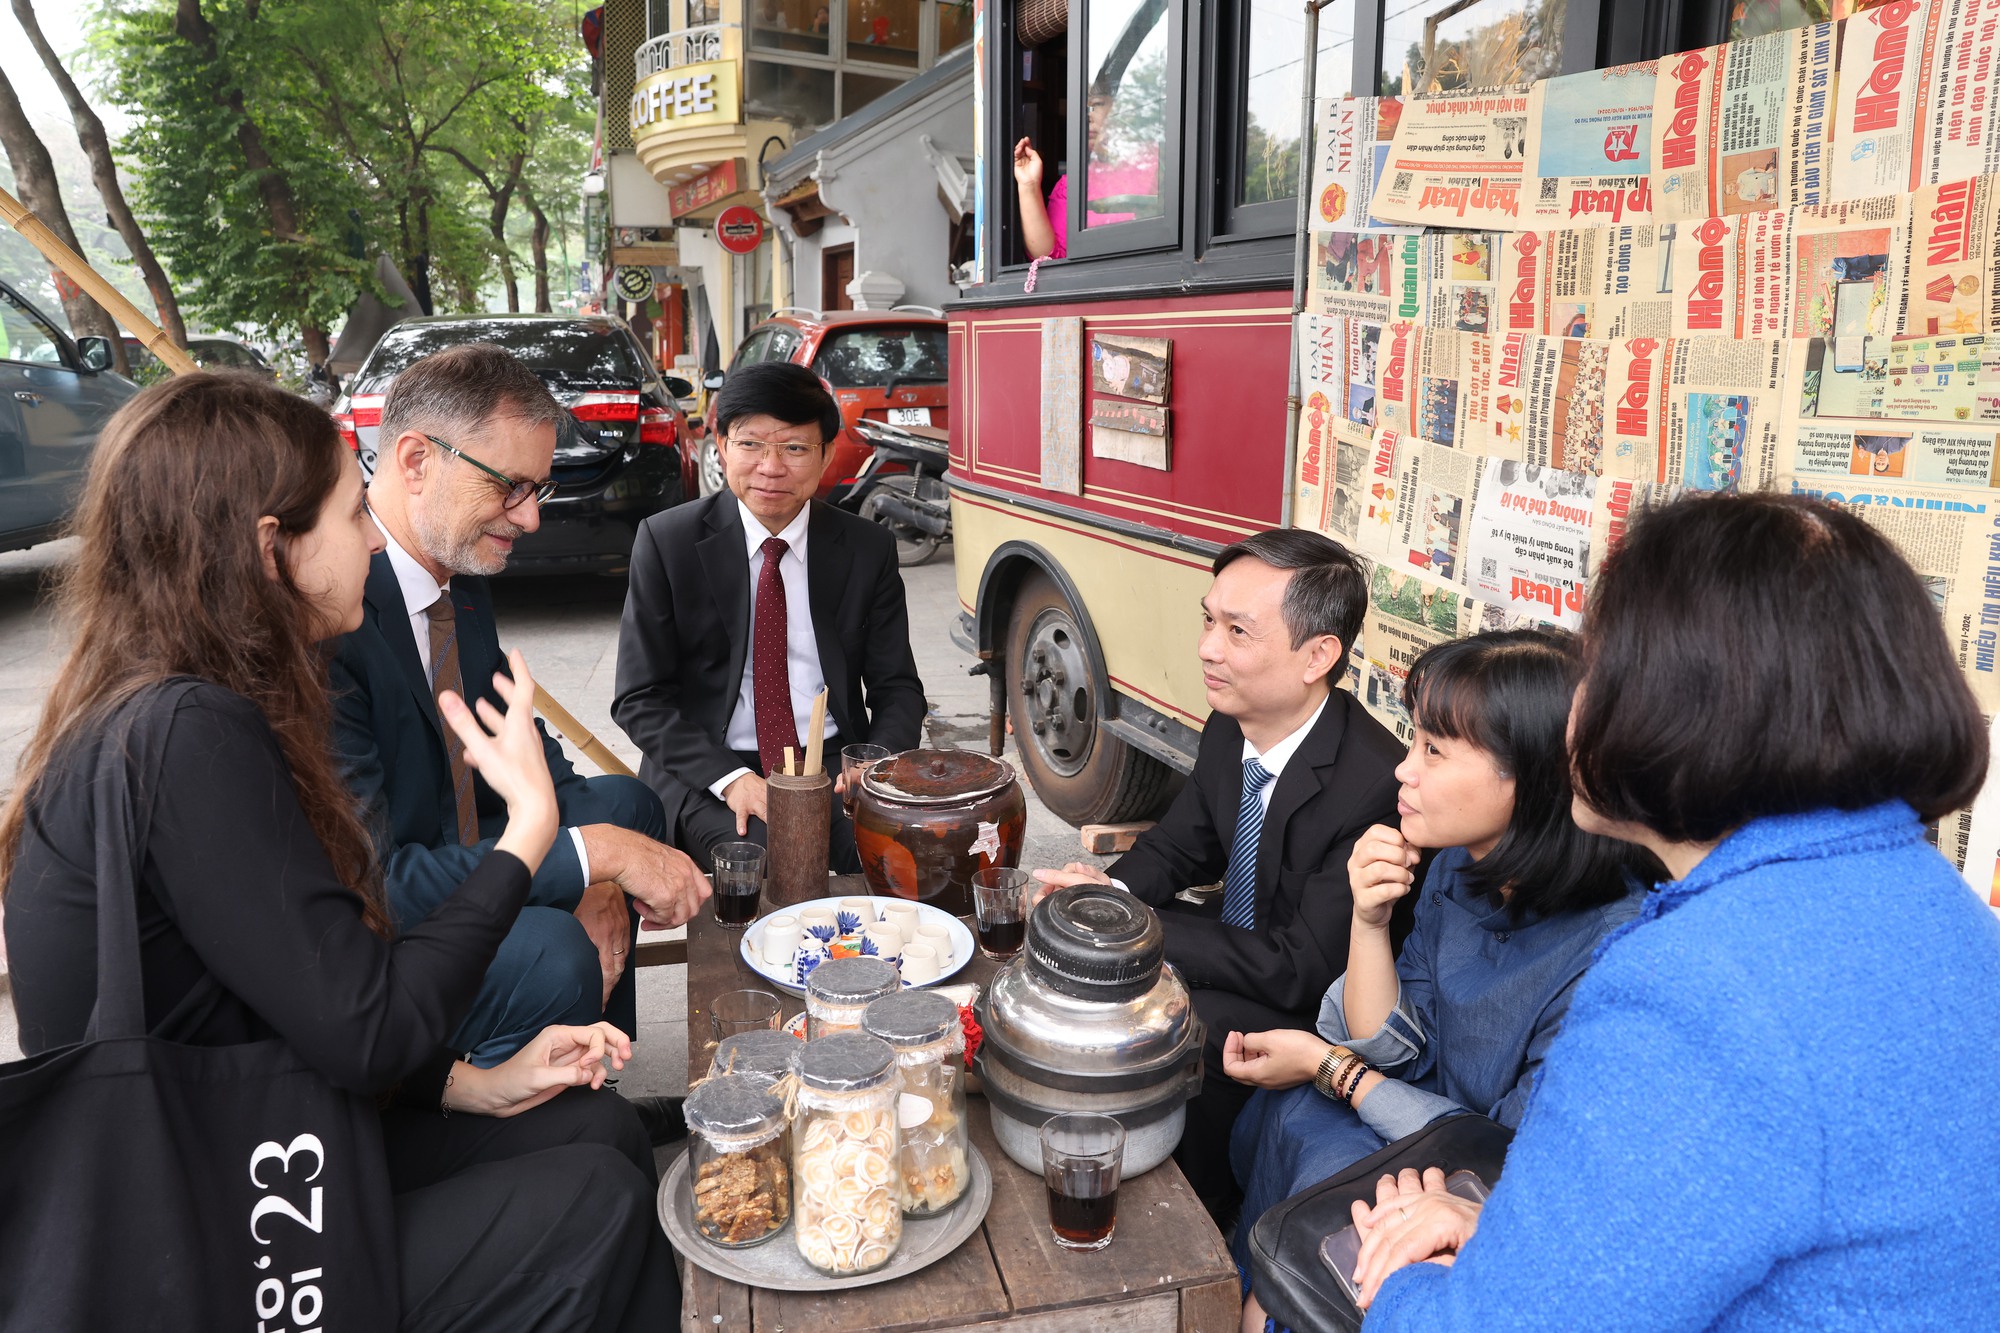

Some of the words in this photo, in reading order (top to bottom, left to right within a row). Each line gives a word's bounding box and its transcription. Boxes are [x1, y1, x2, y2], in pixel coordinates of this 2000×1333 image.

[1924, 20, 1936, 52] QUYẾT
[1979, 14, 1999, 42] hội,
[1811, 42, 1829, 65] LĨNH
[1954, 30, 1975, 70] nhiều
[1715, 53, 1725, 71] CỦA
[1922, 56, 1932, 80] NGHỊ
[1973, 46, 1991, 80] Quốc
[1809, 70, 1827, 86] SÁT
[1713, 75, 1722, 102] QUYẾT
[1919, 86, 1927, 107] ĐƯA
[1949, 75, 1967, 106] toàn
[632, 74, 713, 129] COFFEE
[1426, 100, 1447, 115] phục
[1469, 98, 1482, 112] lực
[1497, 96, 1512, 112] Nội
[1514, 98, 1527, 112] Hà
[1806, 90, 1826, 119] GIÁM
[1970, 87, 1987, 111] đạo
[1330, 103, 1336, 117] B
[1448, 100, 1468, 117] khắc
[1484, 101, 1496, 116] nỗ
[1711, 106, 1720, 127] NGHỊ
[1803, 122, 1822, 139] TÁI
[1948, 111, 1963, 140] Kiện
[1967, 116, 1983, 146] lãnh
[1337, 110, 1353, 173] NHÂN
[1710, 130, 1718, 149] ĐƯA
[1327, 129, 1336, 172] ĐẠI
[1802, 142, 1821, 165] TIÊN
[1800, 167, 1820, 188] ĐẦU
[1418, 186, 1469, 217] luật
[1569, 189, 1625, 223] luật
[1798, 192, 1820, 205] ẦN
[1773, 212, 1785, 230] dậy
[1926, 181, 1967, 266] Nhân
[1756, 225, 1767, 242] rào
[1771, 235, 1782, 258] vươn
[1614, 244, 1632, 272] ĐỒNG
[1754, 246, 1766, 273] khăn,
[1604, 270, 1614, 281] xếp
[1687, 218, 1731, 329] Hànộ
[1768, 263, 1781, 272] tế
[1799, 258, 1808, 276] LÂM
[1509, 231, 1542, 328] Hànộ
[1616, 276, 1631, 294] TẠO
[1753, 276, 1765, 294] khó
[1798, 280, 1807, 289] TÔ
[1399, 267, 1419, 317] Quân
[1604, 283, 1612, 295] Sắp
[1753, 297, 1765, 309] gỡ
[1769, 285, 1783, 314] ngành
[1797, 293, 1806, 306] CHÍ
[1752, 313, 1763, 334] tháo
[1765, 318, 1779, 329] để
[1795, 310, 1806, 333] ĐỒNG
[1352, 320, 1360, 344] bừng
[1319, 325, 1333, 384] NHÂN
[1469, 341, 1480, 354] HÀ
[1482, 344, 1490, 364] BỨT
[1311, 340, 1319, 380] ĐẠI
[1352, 348, 1360, 376] Tưng
[1469, 359, 1480, 372] ĐỂ
[1498, 333, 1522, 387] Nhân
[1471, 378, 1479, 396] CỘT
[1615, 338, 1659, 436] Hànộ
[900, 411, 920, 423] 30E
[1470, 401, 1478, 420] TRỤ
[1480, 396, 1489, 423] TĂNG
[1798, 439, 1814, 448] trưởng
[1809, 431, 1814, 439] số
[1834, 433, 1840, 441] tế
[1841, 433, 1851, 441] kinh
[1922, 436, 1936, 445] Đảng
[1957, 438, 1966, 447] hội
[1967, 439, 1976, 448] Đại
[1803, 448, 1815, 457] trọng
[1827, 441, 1840, 449] phần
[1841, 441, 1850, 449] góp
[1934, 447, 1945, 456] kiện
[1970, 448, 1979, 457] Dự
[1978, 440, 1991, 448] trình
[1374, 430, 1396, 477] Nhân
[1815, 457, 1831, 466] nghiệp
[1830, 452, 1836, 460] tố
[1837, 451, 1849, 459] nhân
[1957, 449, 1968, 457] thảo
[1833, 460, 1848, 468] Doanh
[1946, 466, 1964, 475] những
[1949, 458, 1957, 466] lớn
[1980, 459, 1988, 468] chủ
[1965, 468, 1978, 476] sung
[1980, 470, 1987, 478] Bổ
[1501, 492, 1511, 506] lỡ
[1513, 496, 1525, 514] bỏ
[1606, 481, 1634, 518] đội
[1397, 510, 1405, 523] Tổng
[1526, 500, 1546, 519] thể
[1549, 501, 1586, 525] không
[1492, 528, 1498, 539] tế
[1500, 529, 1503, 537] y
[1505, 531, 1511, 541] bị
[1512, 534, 1527, 545] thiết
[1529, 537, 1535, 547] lý
[1537, 539, 1553, 550] quản
[1556, 543, 1574, 555] trong
[1515, 547, 1527, 558] cấp
[1529, 550, 1545, 561] phân
[1547, 555, 1561, 565] xuất
[1564, 559, 1573, 568] Đề
[1510, 577, 1561, 617] luật
[1974, 604, 1999, 625] TÍN
[1957, 653, 1967, 668] sách
[1962, 614, 1972, 638] I-2024:
[1388, 645, 1403, 660] trị
[1971, 630, 1997, 672] NHIỀU
